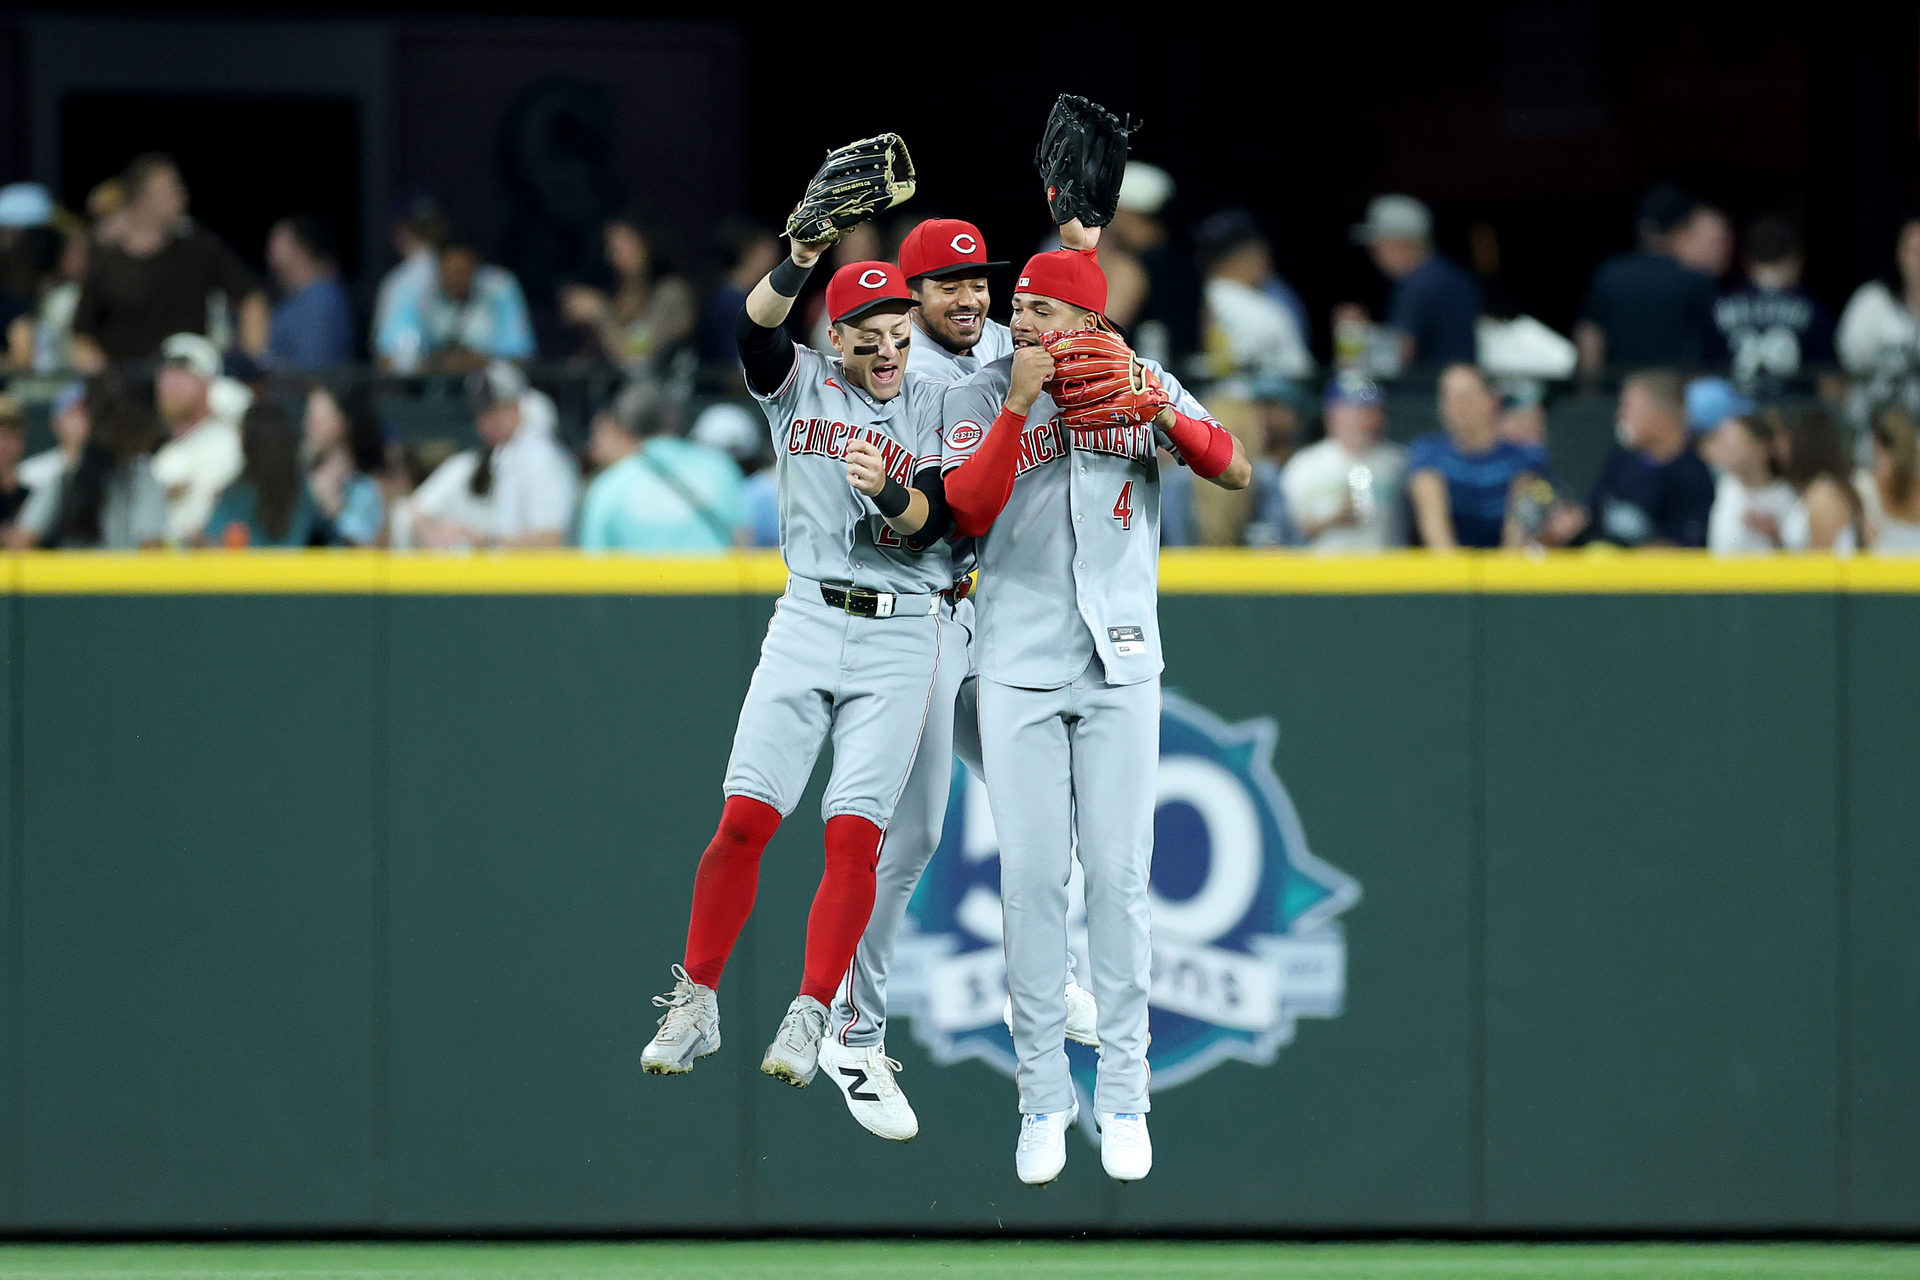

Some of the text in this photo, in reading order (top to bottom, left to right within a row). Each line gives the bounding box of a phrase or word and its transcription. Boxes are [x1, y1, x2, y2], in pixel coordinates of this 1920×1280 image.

[950, 233, 977, 254] C
[858, 269, 888, 289] C
[953, 431, 980, 440] REDS
[788, 417, 917, 488] CINCINA
[1113, 480, 1134, 530] 4
[838, 1066, 881, 1102] N
